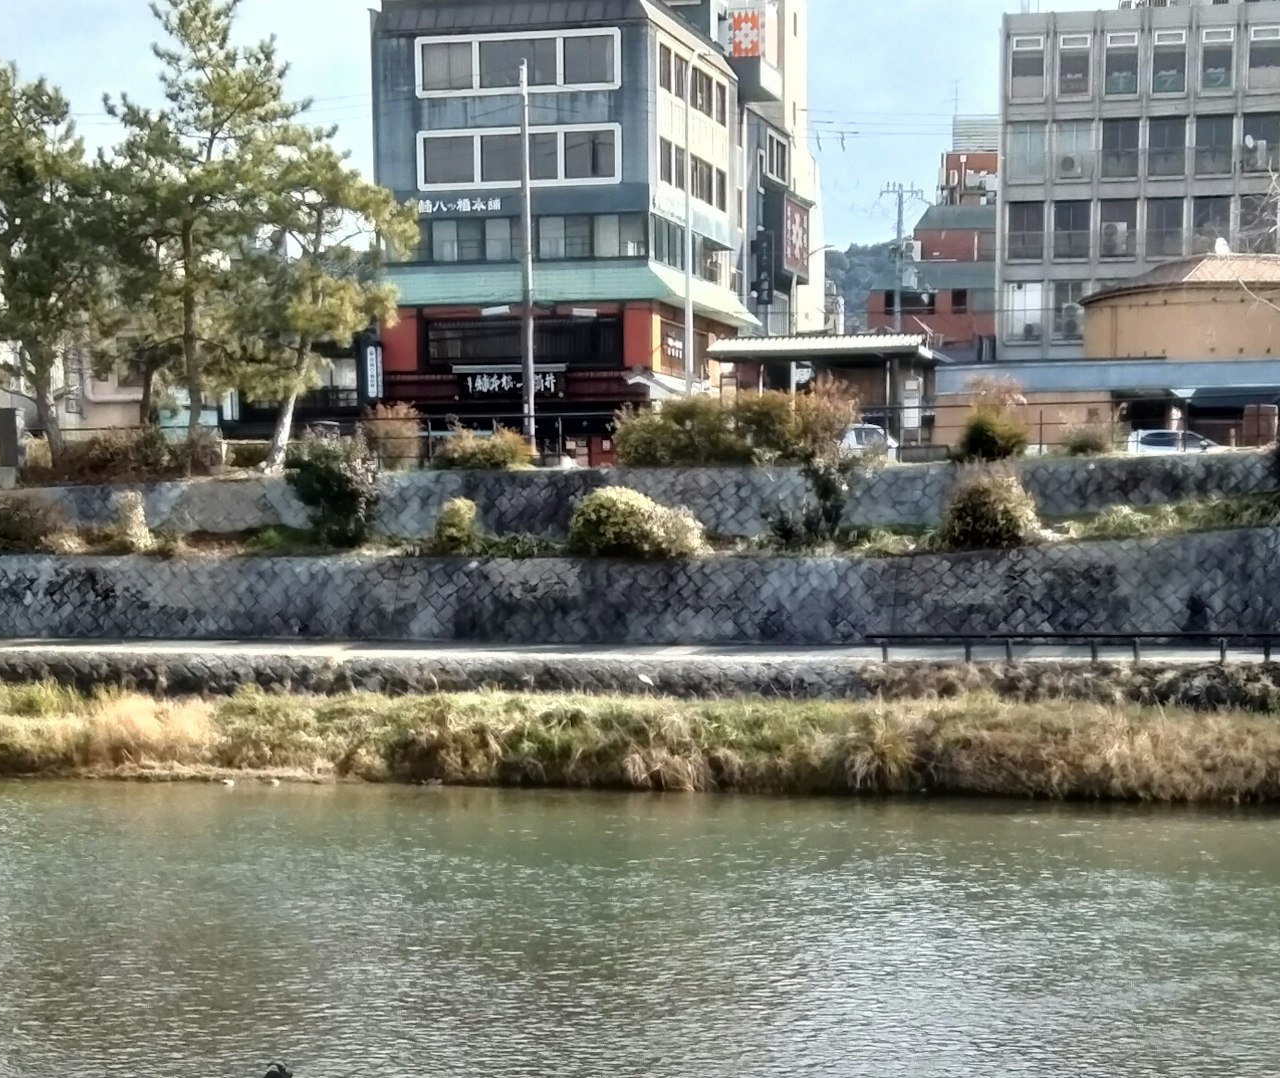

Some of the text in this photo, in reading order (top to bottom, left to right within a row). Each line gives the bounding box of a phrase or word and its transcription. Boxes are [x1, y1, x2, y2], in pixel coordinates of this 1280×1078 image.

[405, 197, 502, 214] 筒八ッ橋本舗
